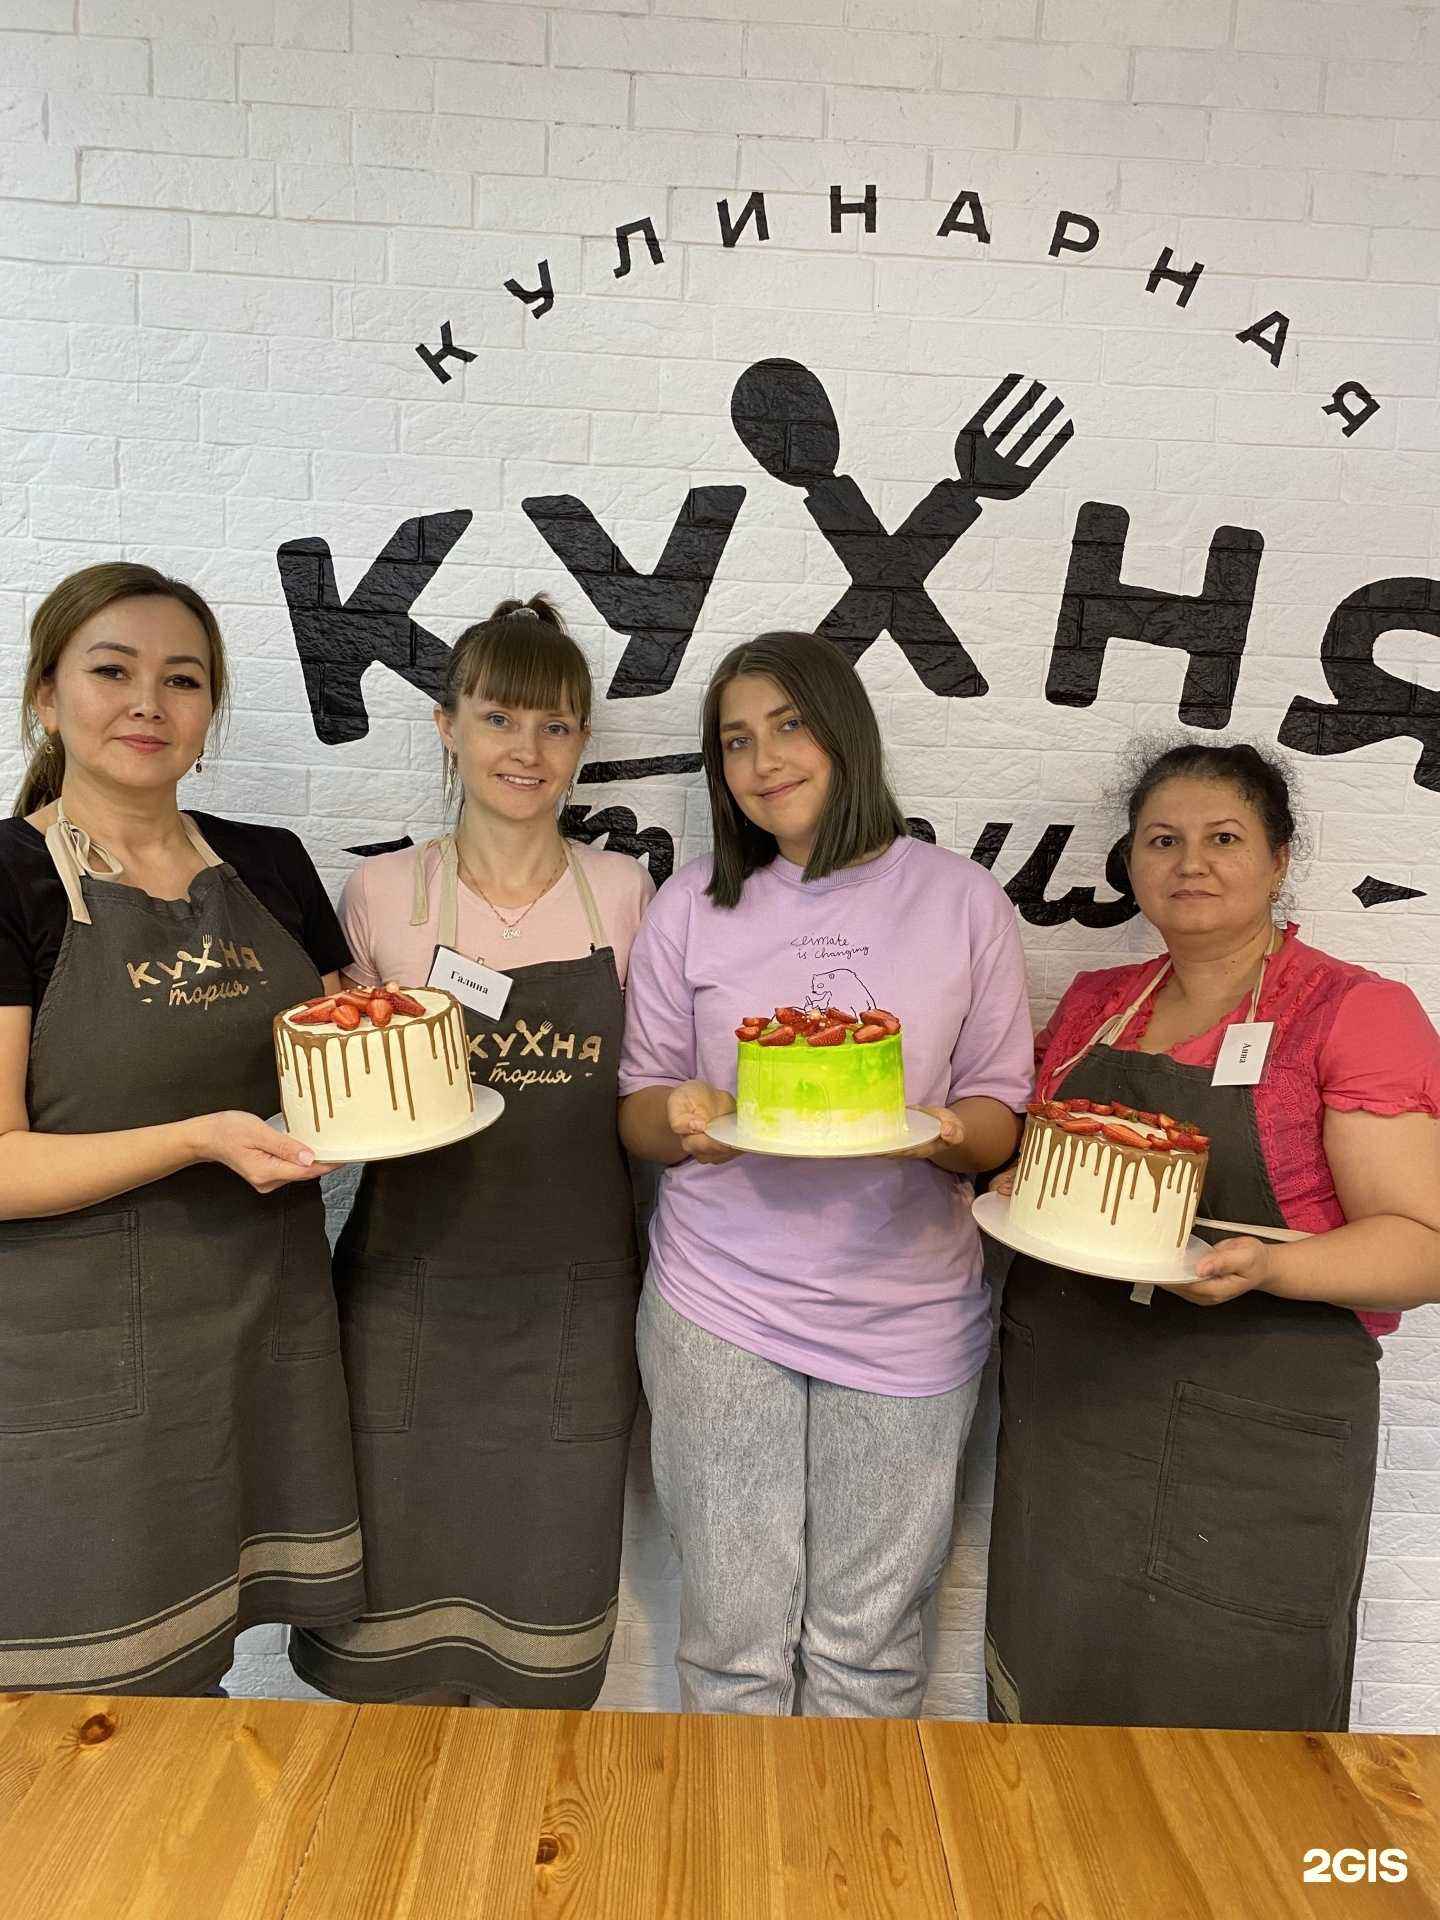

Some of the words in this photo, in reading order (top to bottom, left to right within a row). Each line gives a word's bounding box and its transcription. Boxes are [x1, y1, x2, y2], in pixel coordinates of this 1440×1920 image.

[415, 184, 1381, 438] КУЛИНАРНАЯ
[277, 474, 1440, 793] КУХНЯ
[126, 934, 264, 989] КУХНЯ
[797, 948, 807, 960] is
[814, 945, 870, 960] changing
[450, 970, 489, 995] Галина
[466, 1019, 602, 1064] КУХНЯ
